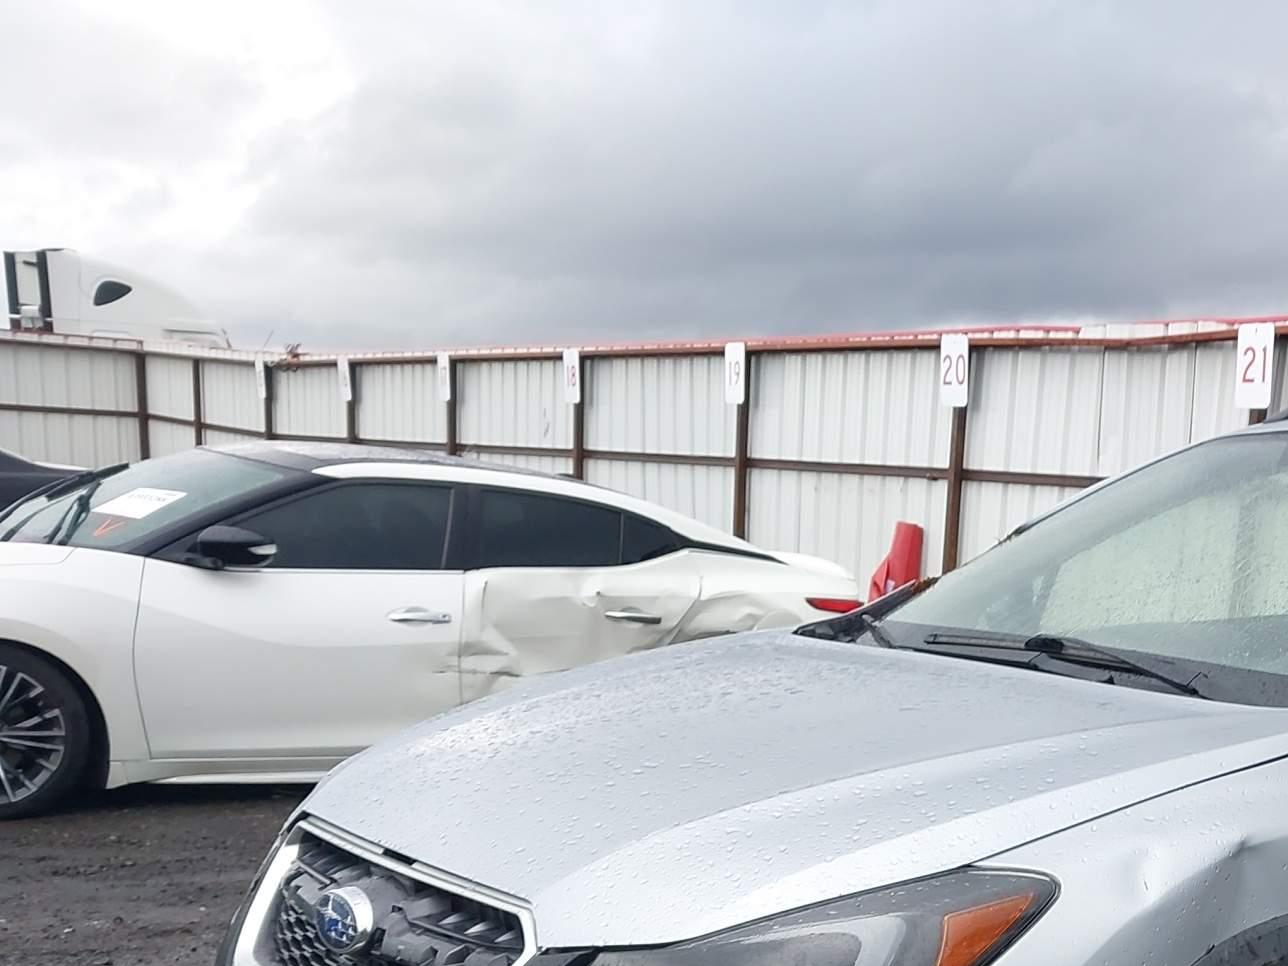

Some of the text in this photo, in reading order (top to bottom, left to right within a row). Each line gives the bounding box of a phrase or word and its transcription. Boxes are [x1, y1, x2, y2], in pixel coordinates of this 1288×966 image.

[566, 365, 577, 388] 18
[728, 361, 741, 386] 19
[943, 354, 966, 385] 20
[1242, 345, 1268, 383] 21
